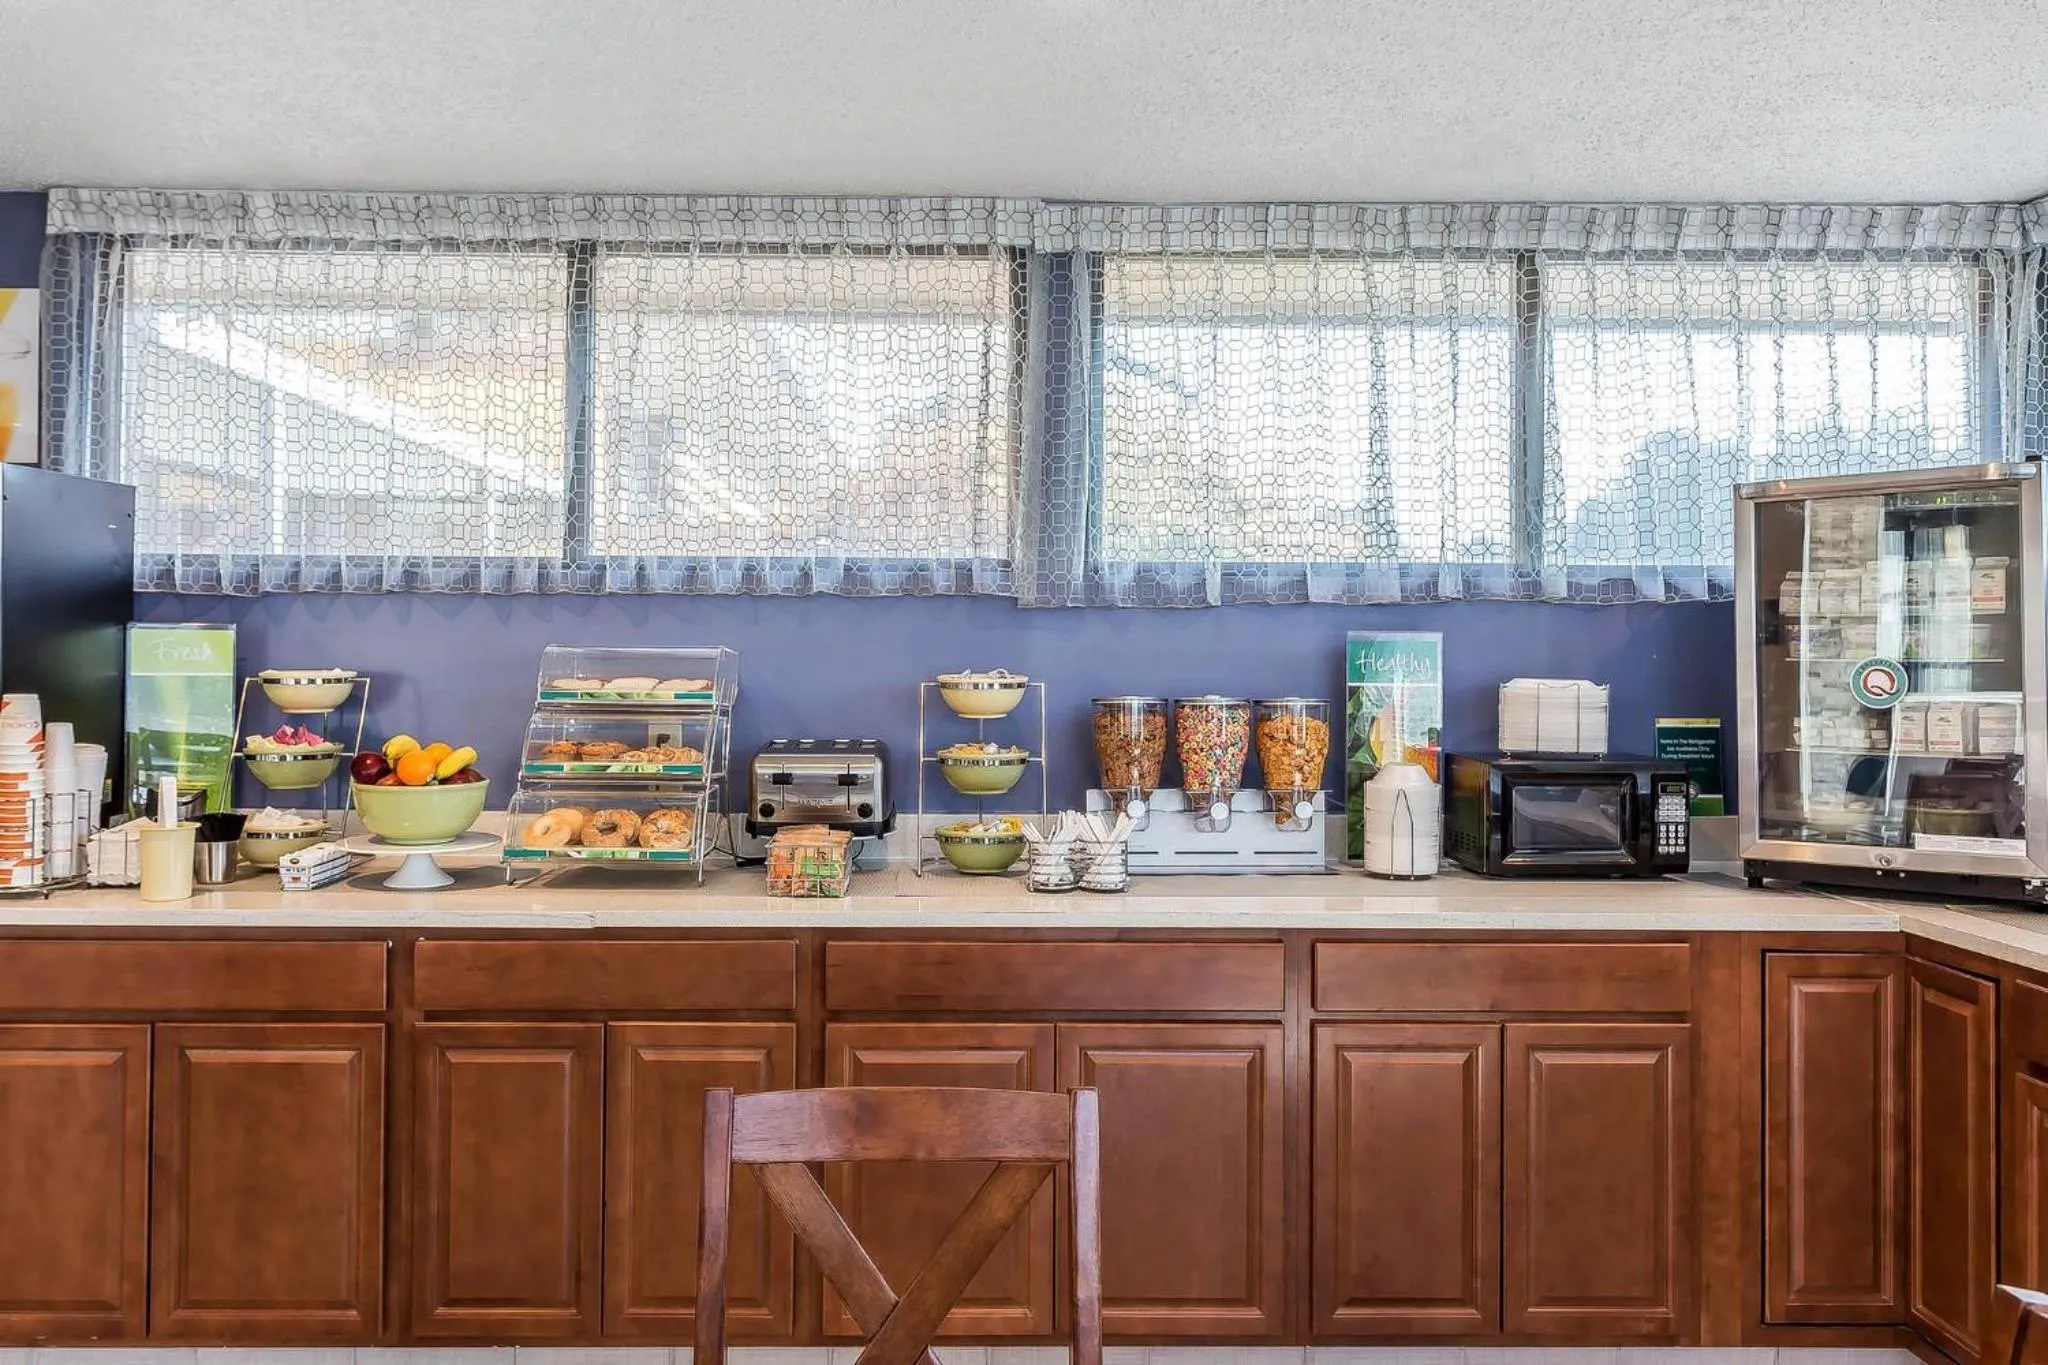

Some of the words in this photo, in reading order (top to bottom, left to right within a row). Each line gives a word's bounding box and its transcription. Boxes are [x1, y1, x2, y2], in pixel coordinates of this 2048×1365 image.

[147, 637, 213, 662] Fresh
[1356, 649, 1432, 678] Healthy
[1861, 667, 1900, 698] Q
